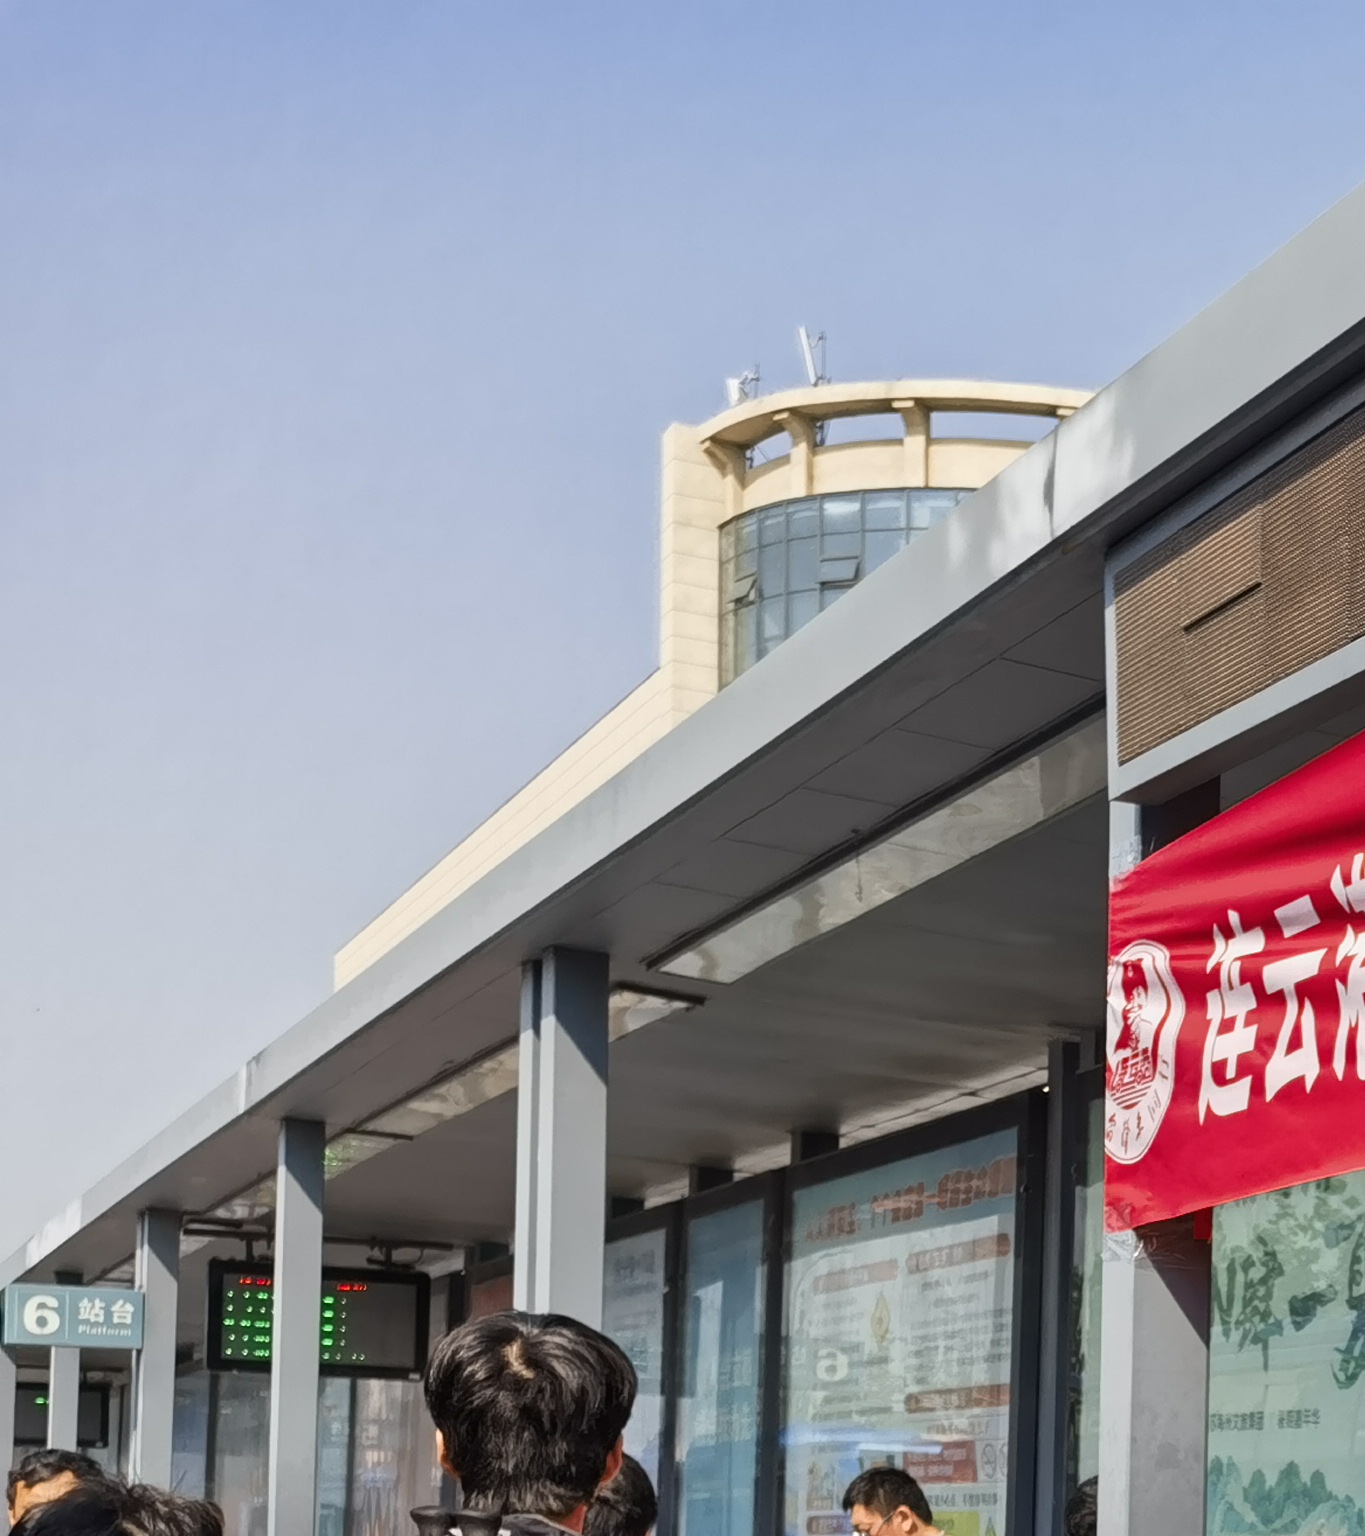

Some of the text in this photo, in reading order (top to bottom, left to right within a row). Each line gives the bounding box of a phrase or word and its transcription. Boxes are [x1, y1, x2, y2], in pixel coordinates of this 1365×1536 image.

[23, 1294, 61, 1336] 6
[77, 1297, 136, 1326] 站台
[78, 1324, 133, 1337] Platform
